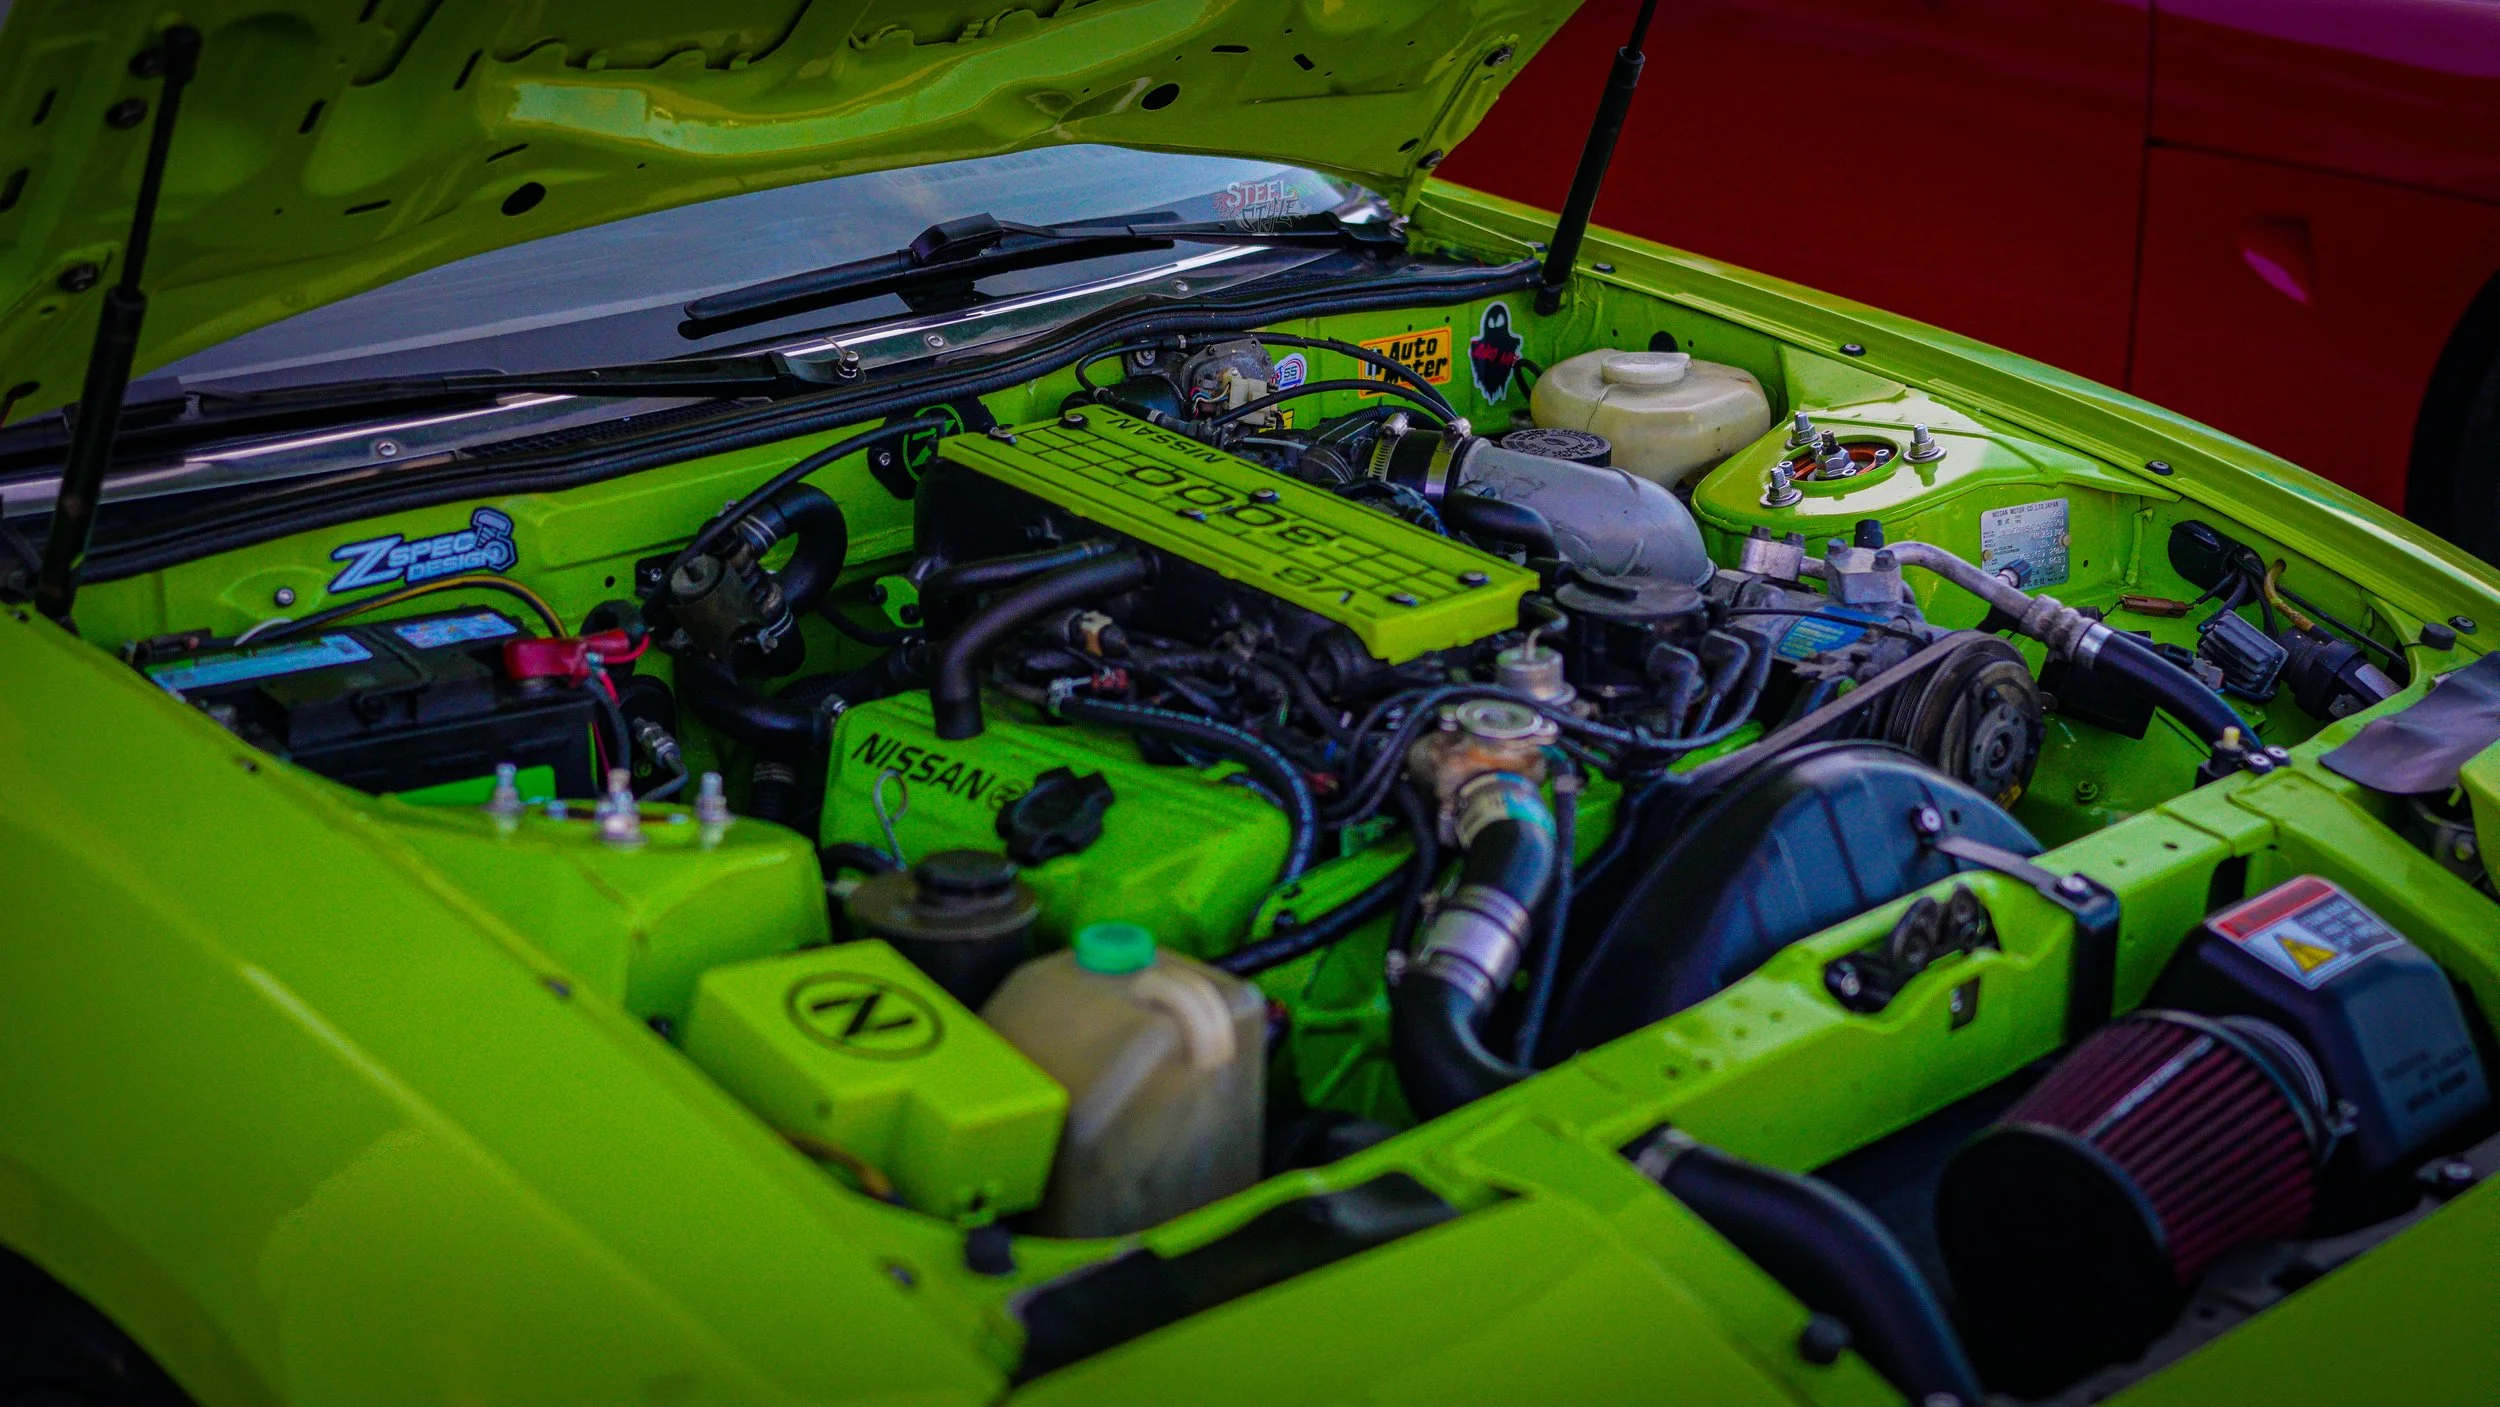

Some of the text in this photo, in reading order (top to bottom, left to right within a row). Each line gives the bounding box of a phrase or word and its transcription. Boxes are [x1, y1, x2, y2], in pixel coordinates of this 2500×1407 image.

[1226, 180, 1295, 208] STEEL
[1389, 337, 1438, 363] Auto
[1384, 357, 1449, 385] Mter
[1106, 418, 1227, 465] NISSAN
[1125, 465, 1341, 547] 3000
[406, 550, 502, 582] DESIGN
[1273, 567, 1356, 604] V6
[851, 732, 996, 801] NISSAN
